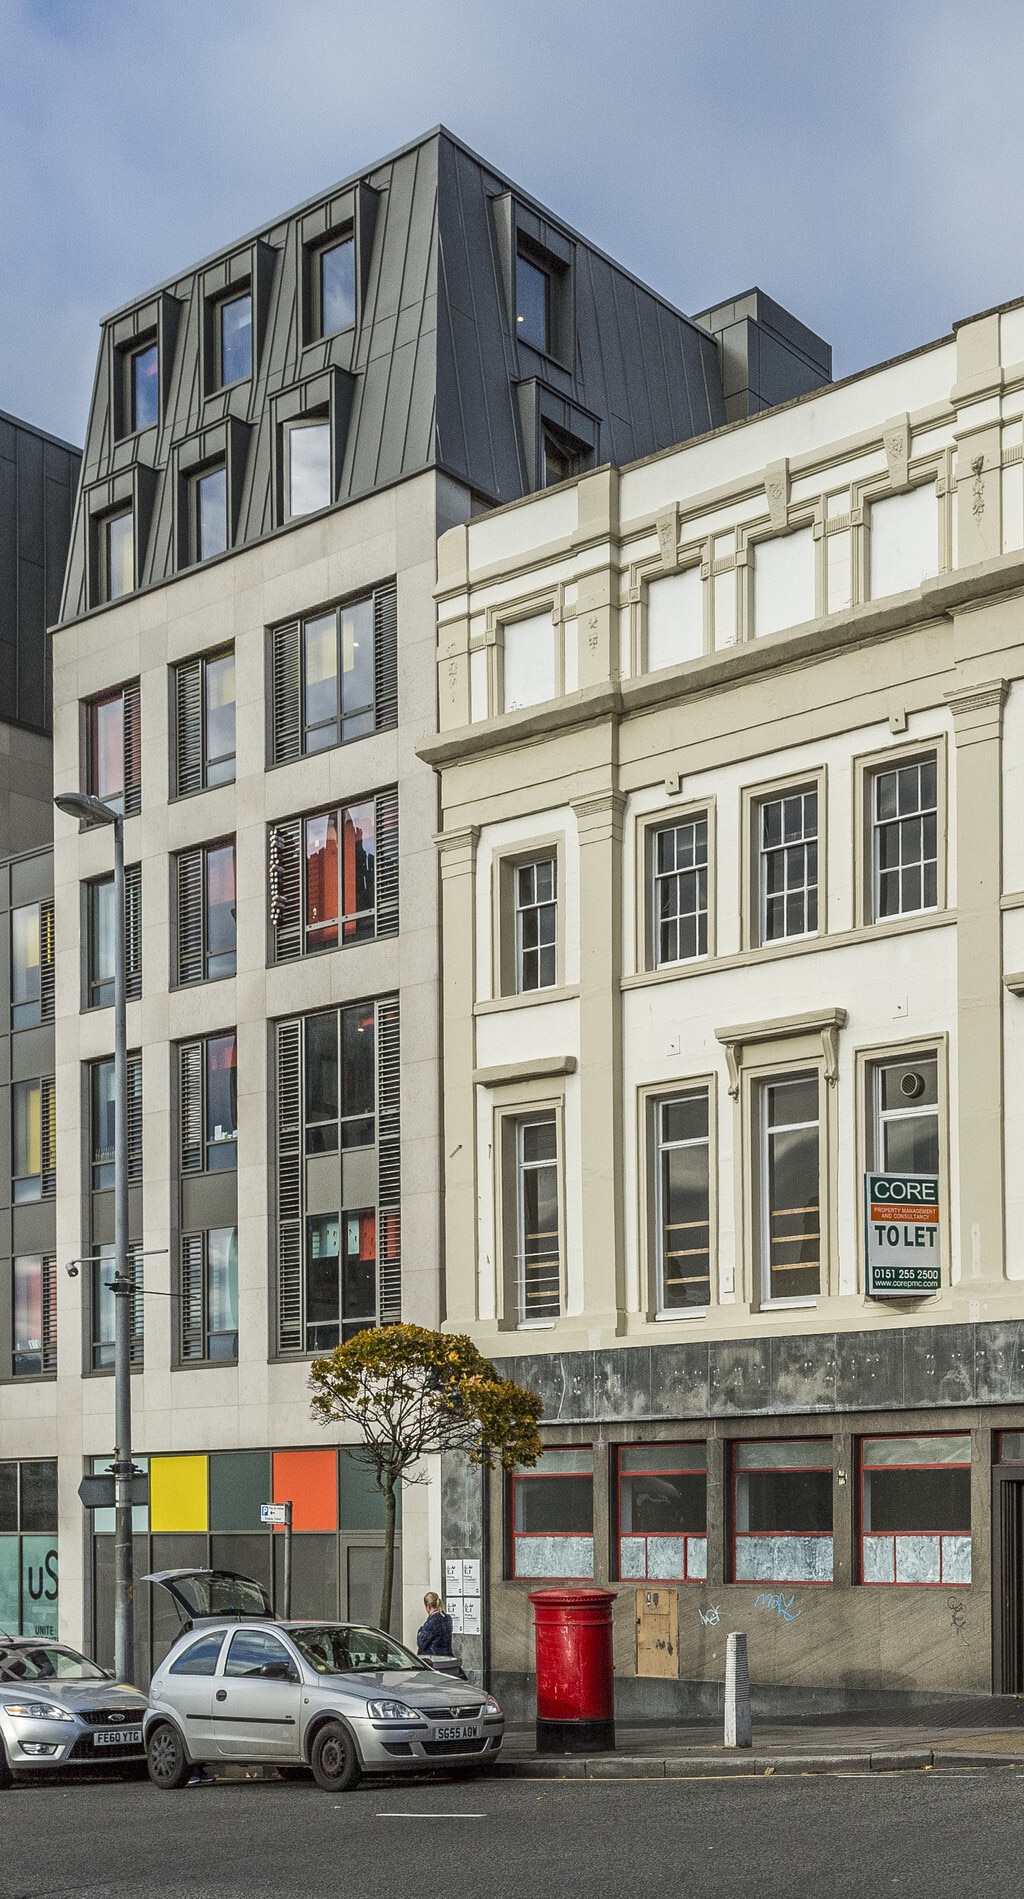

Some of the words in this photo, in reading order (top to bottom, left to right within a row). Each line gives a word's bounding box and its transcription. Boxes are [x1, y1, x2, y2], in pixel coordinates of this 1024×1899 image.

[874, 1181, 936, 1200] CORE
[874, 1225, 900, 1247] TO
[904, 1225, 938, 1248] LET
[874, 1268, 895, 1279] 0151
[898, 1269, 915, 1279] 255
[917, 1269, 938, 1280] 2500
[874, 1280, 938, 1288] www.corepmc.com
[34, 1625, 54, 1636] UNITE
[97, 1732, 121, 1743] FE60
[122, 1731, 139, 1742] YTG
[438, 1727, 461, 1739] SG55
